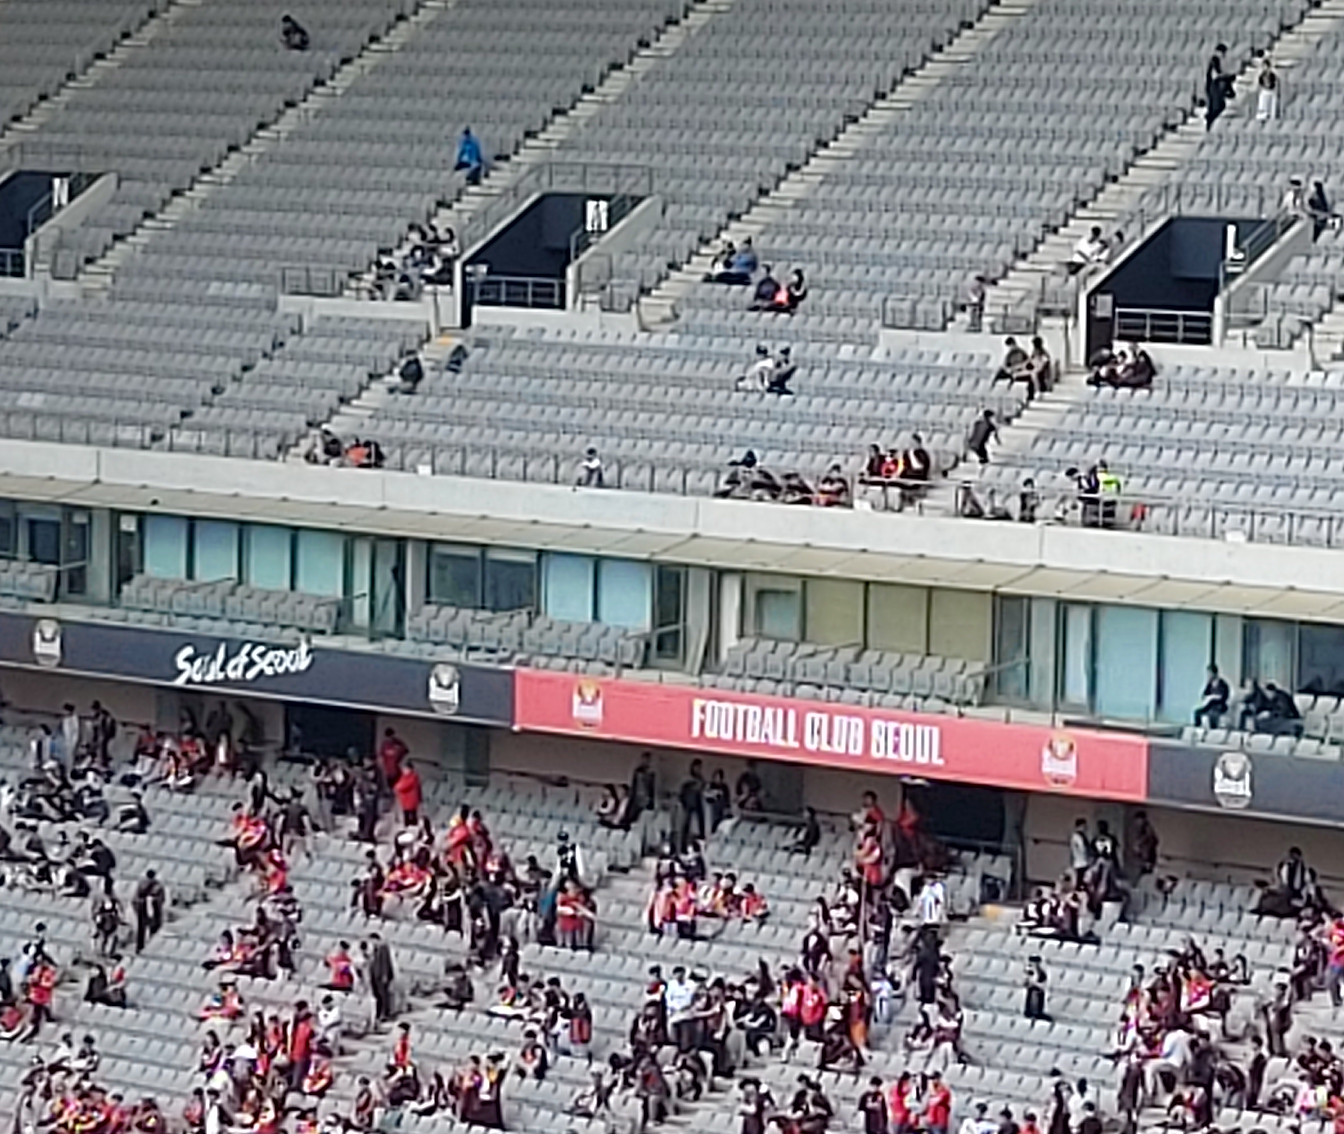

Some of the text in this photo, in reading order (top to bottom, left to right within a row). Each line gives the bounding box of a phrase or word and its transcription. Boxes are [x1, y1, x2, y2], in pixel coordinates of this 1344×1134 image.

[691, 699, 944, 765] FOOTBALL CLUB SEOUL
